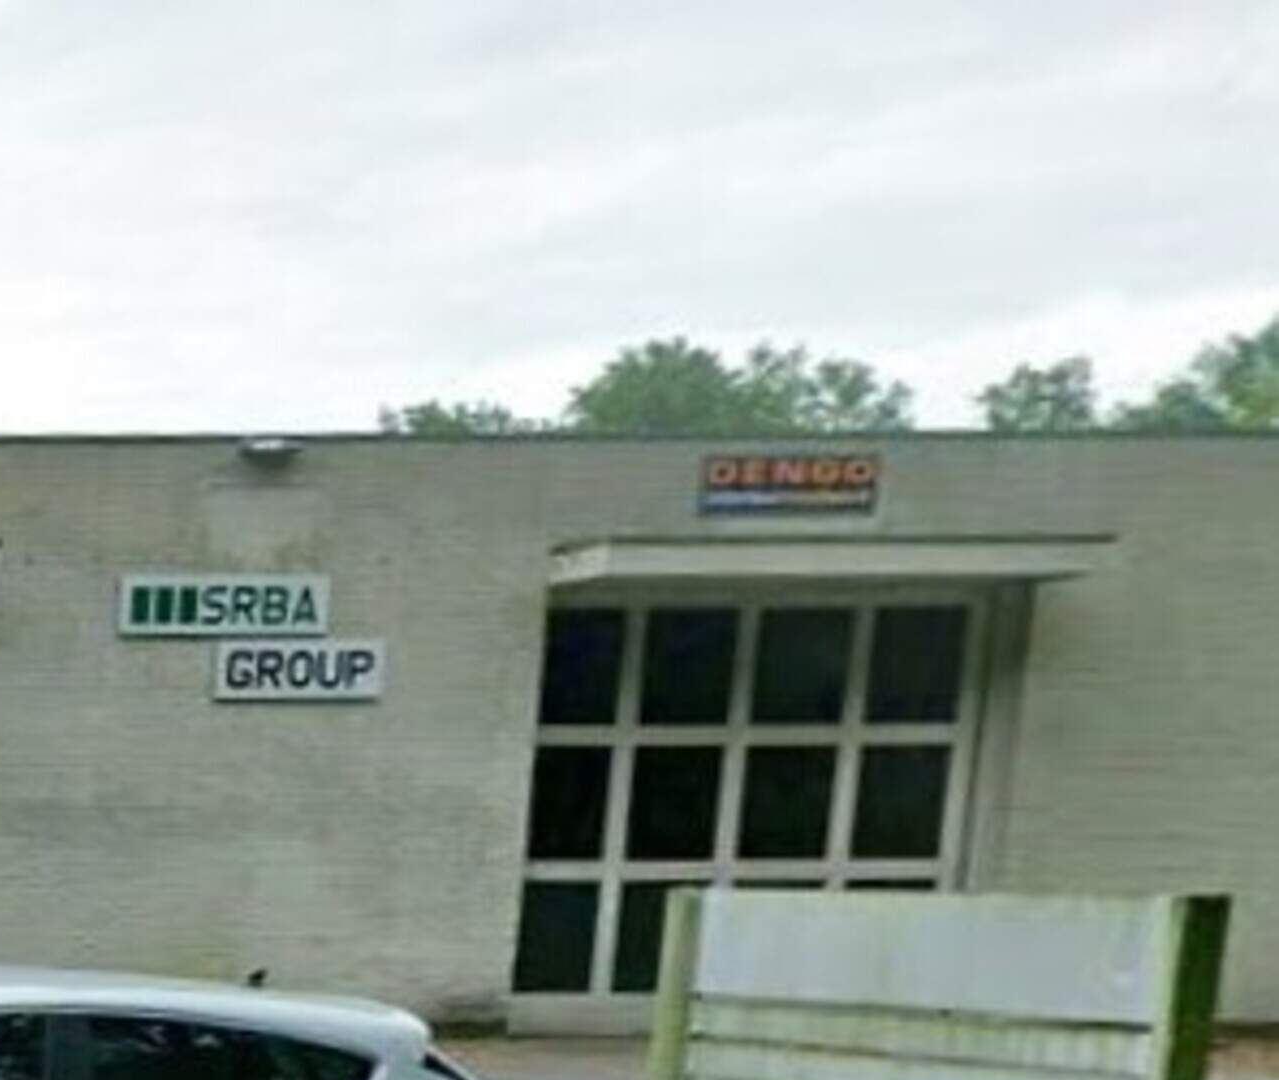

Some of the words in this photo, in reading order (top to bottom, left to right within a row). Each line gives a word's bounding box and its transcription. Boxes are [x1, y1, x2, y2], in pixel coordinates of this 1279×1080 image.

[709, 460, 874, 485] DENGO
[201, 585, 318, 625] SRBA
[226, 650, 376, 689] GROUP
